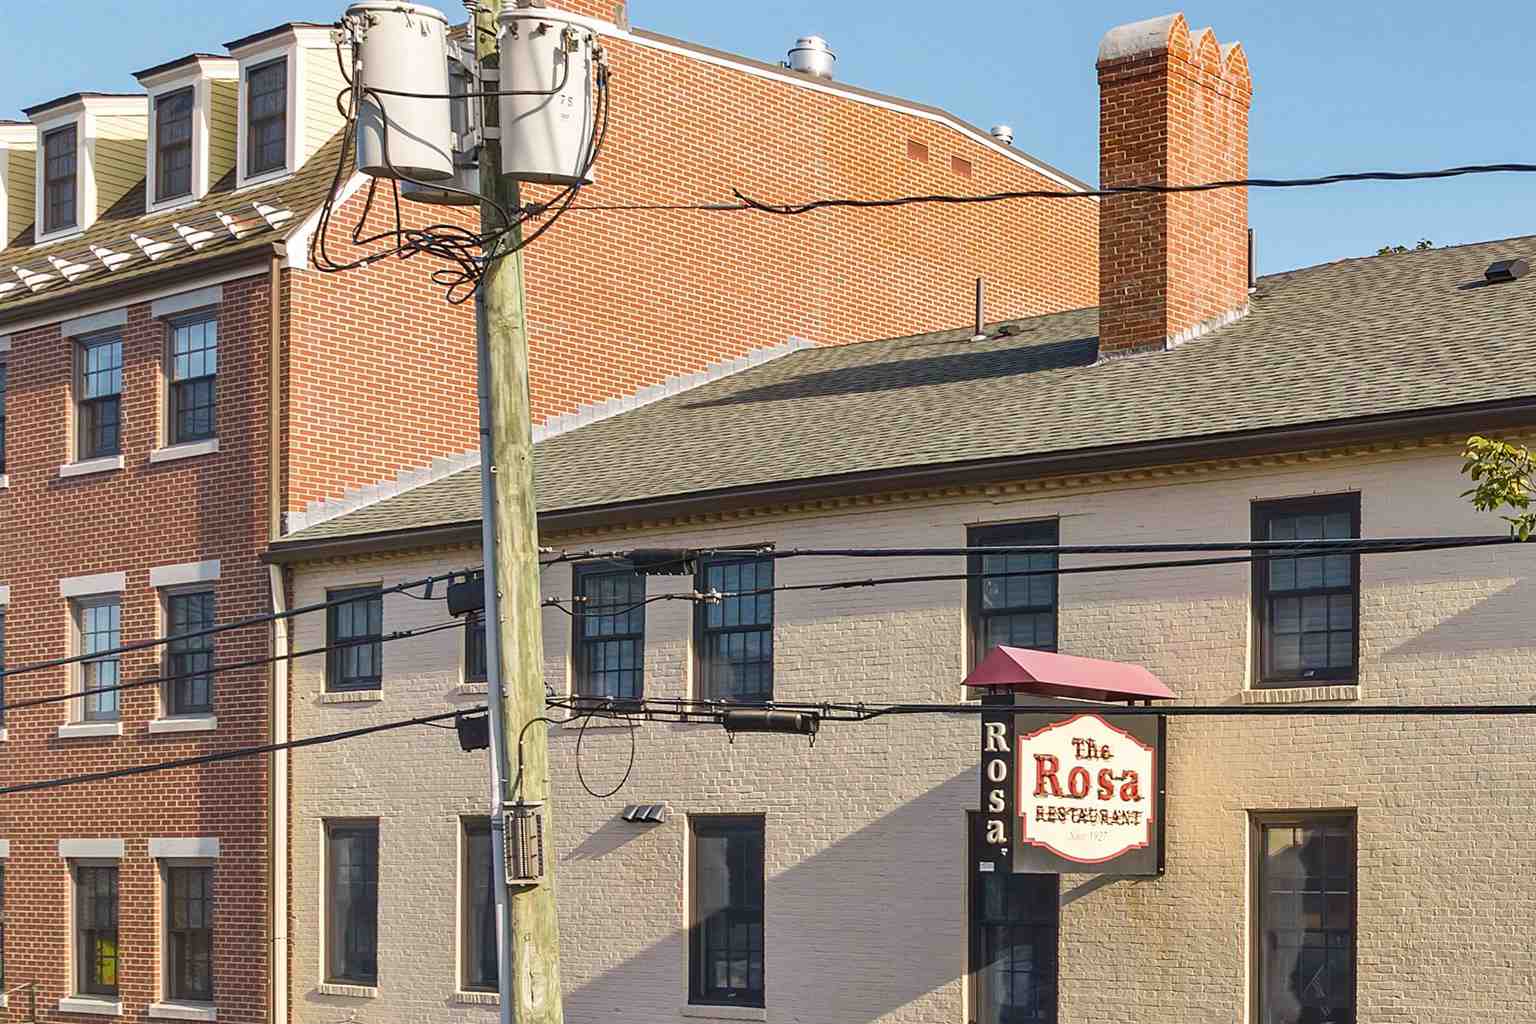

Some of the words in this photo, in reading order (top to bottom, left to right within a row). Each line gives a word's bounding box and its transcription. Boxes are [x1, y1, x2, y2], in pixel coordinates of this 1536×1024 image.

[1072, 737, 1115, 760] The
[984, 722, 1010, 844] Rosa
[1032, 753, 1145, 803] Rosa
[1035, 805, 1143, 826] RESTAURANT
